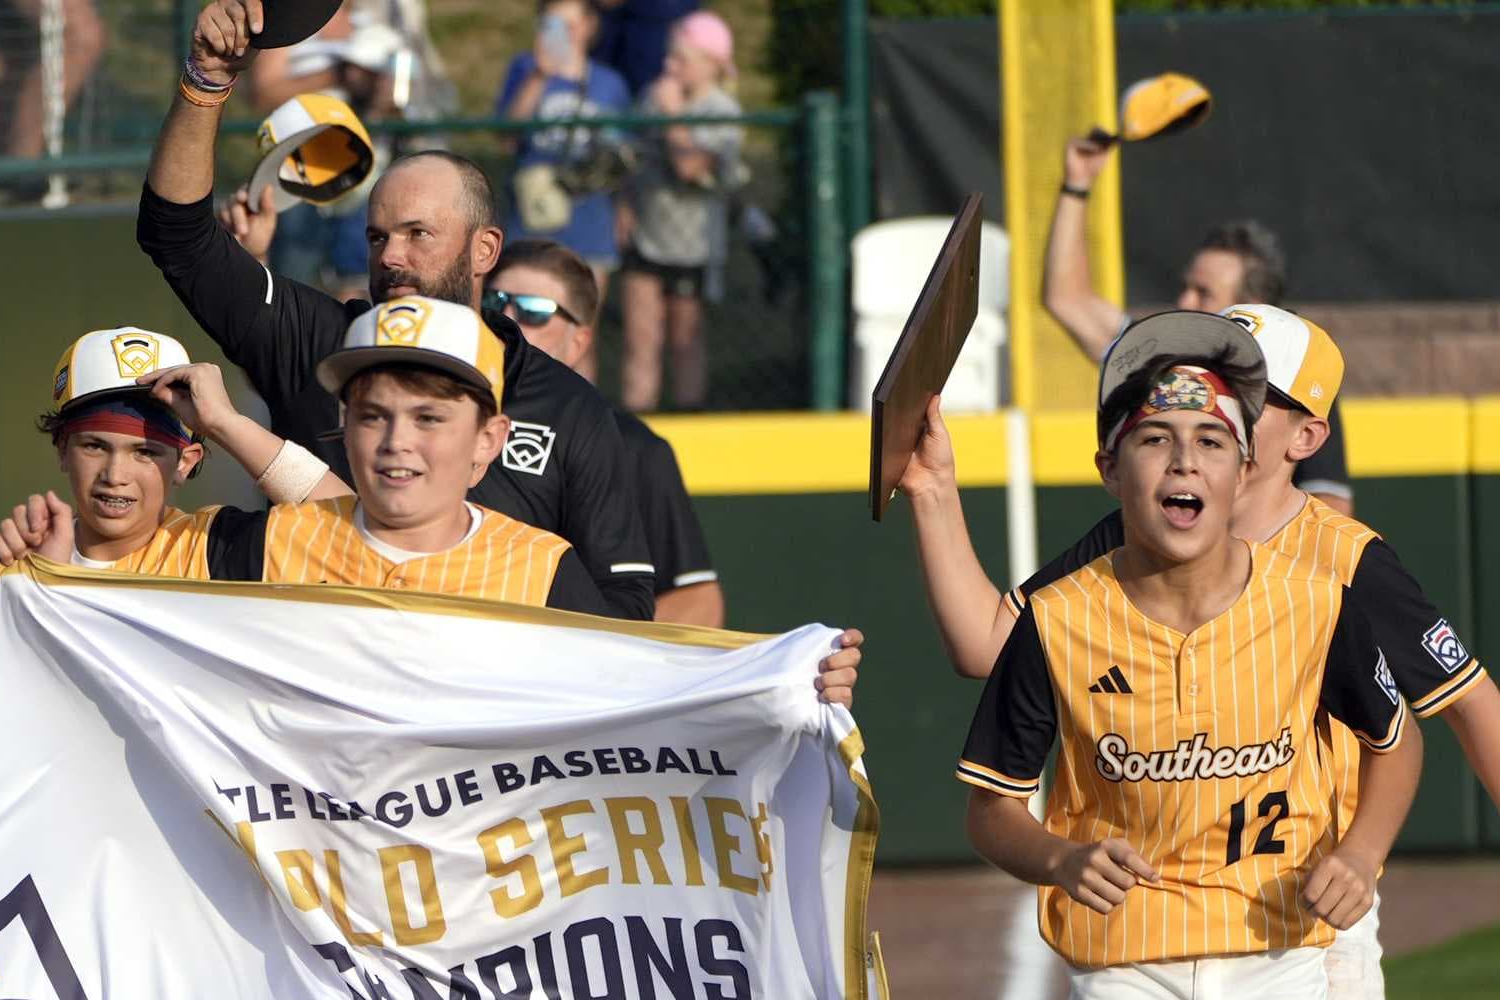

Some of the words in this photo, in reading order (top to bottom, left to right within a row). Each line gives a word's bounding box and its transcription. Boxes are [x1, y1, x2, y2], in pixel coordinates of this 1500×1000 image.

[491, 747, 738, 794] BASEBALL
[1095, 727, 1295, 783] Southeast
[1225, 790, 1290, 866] 12
